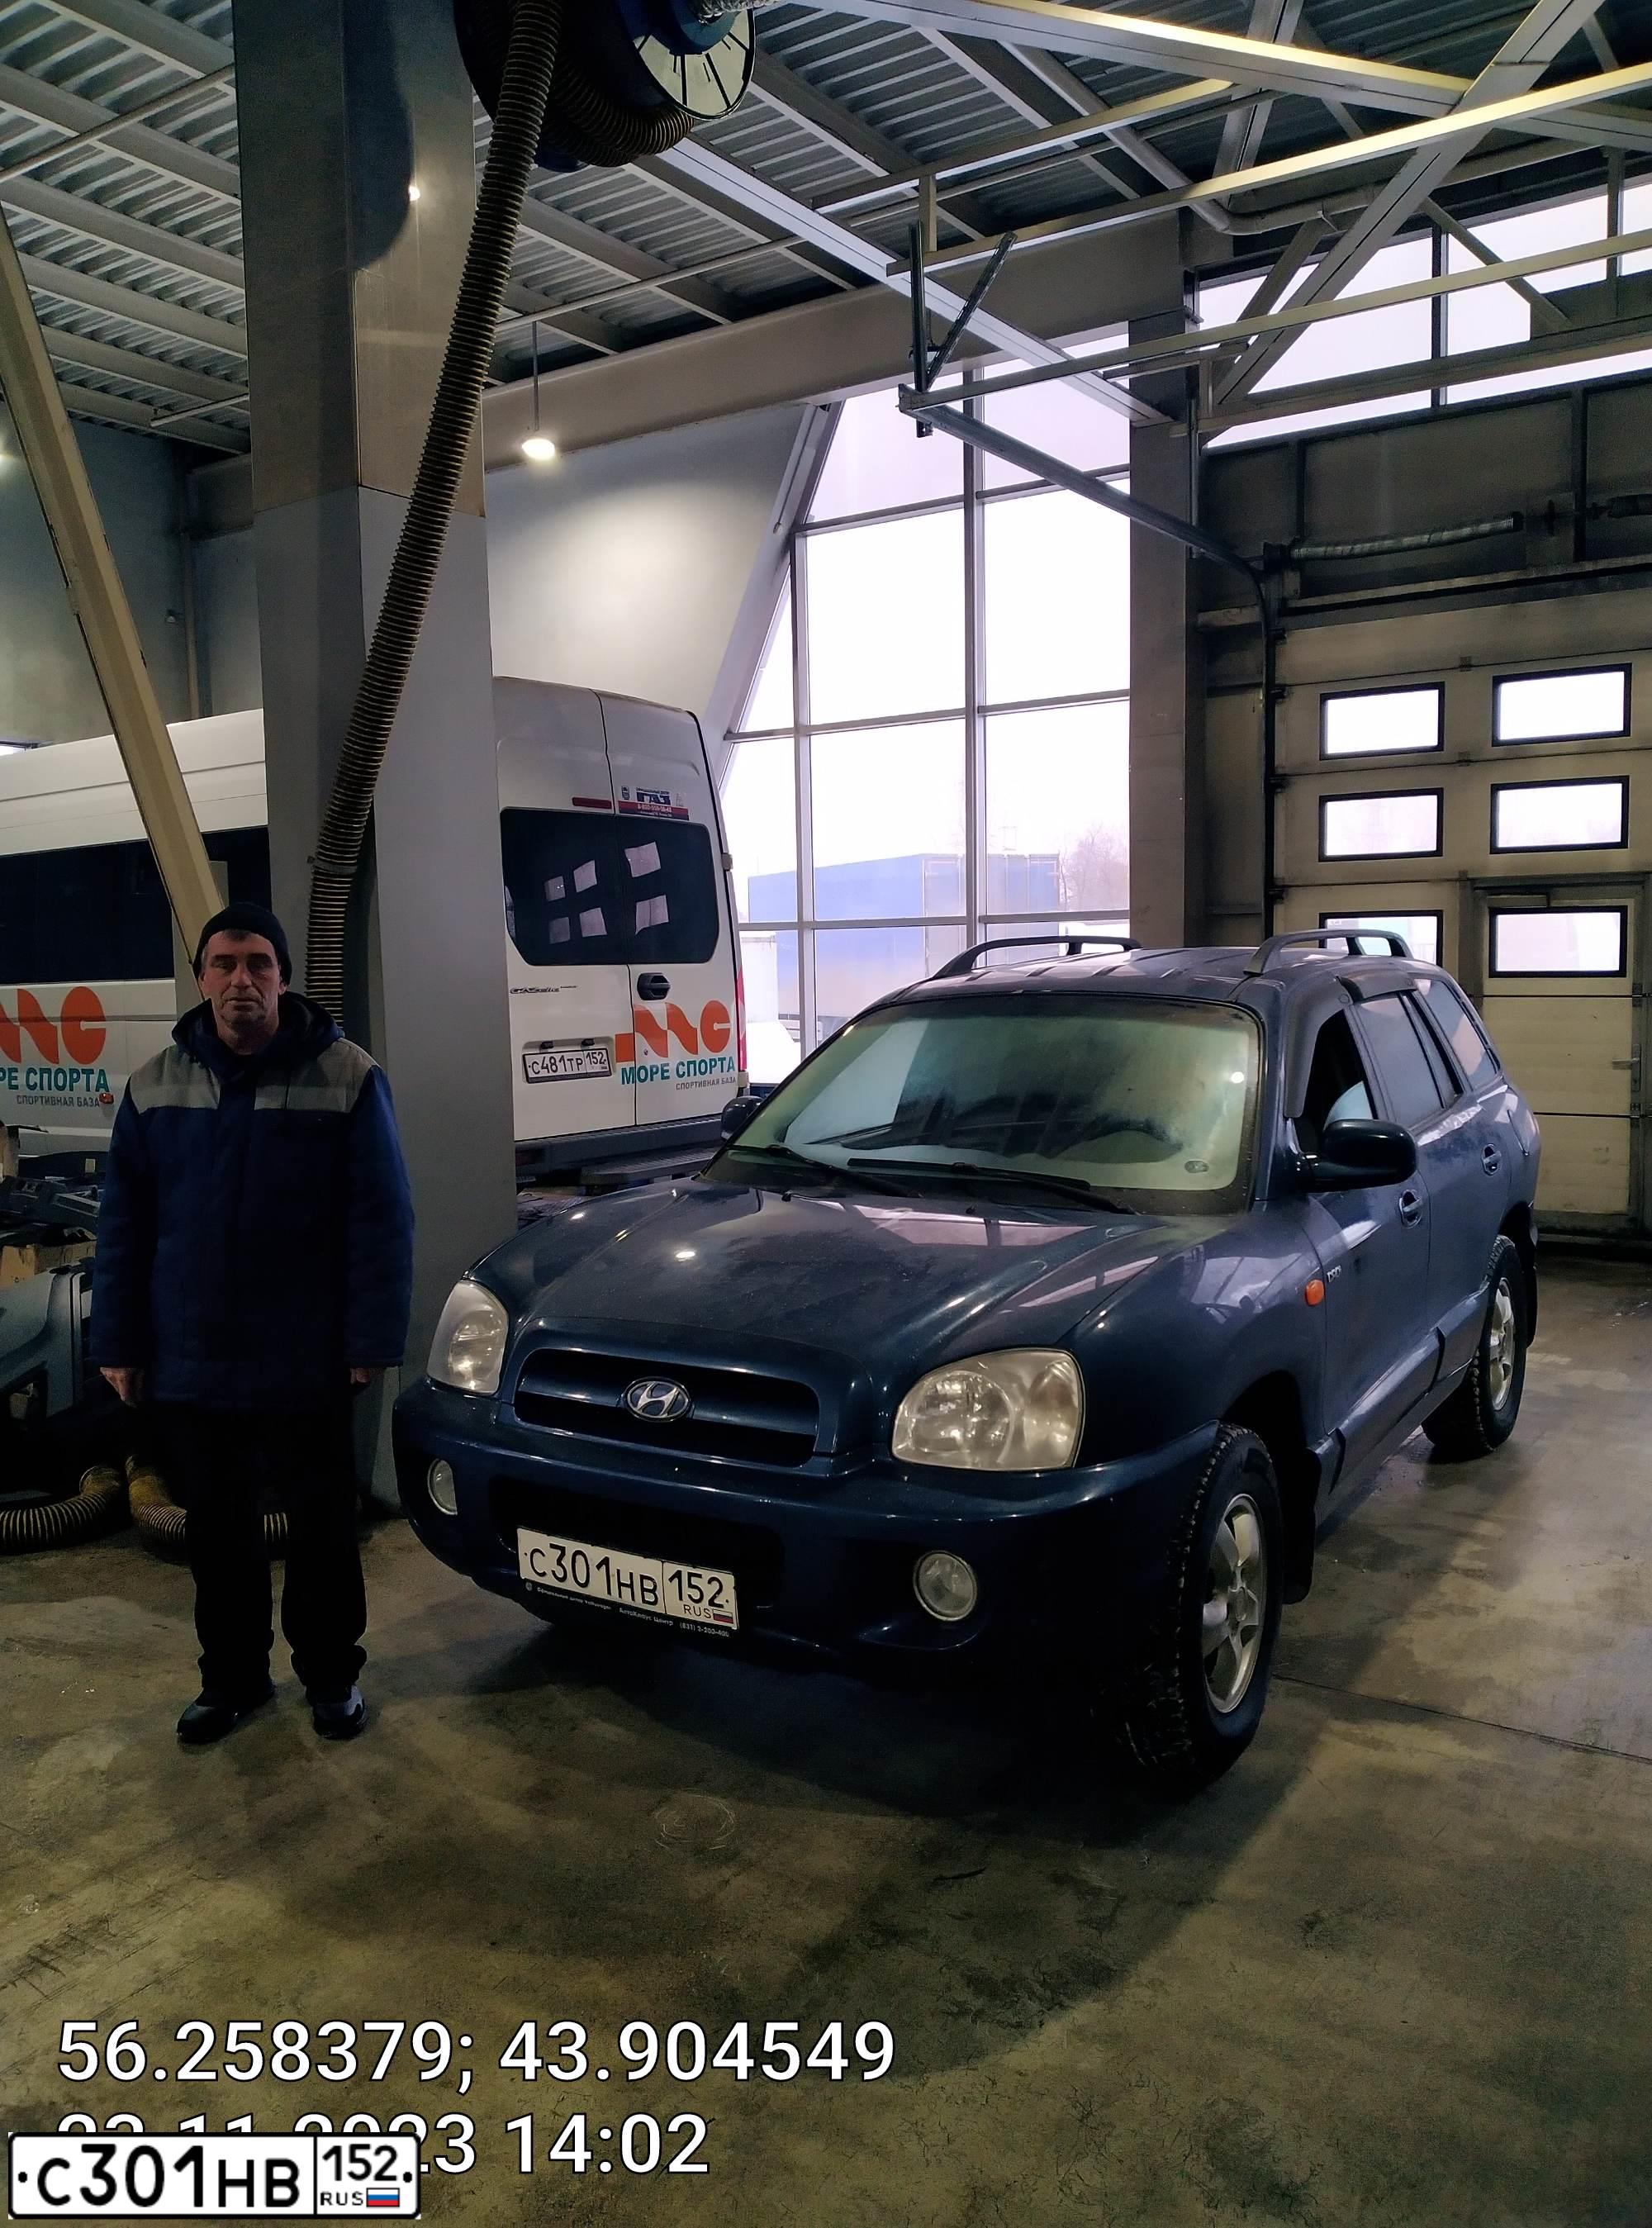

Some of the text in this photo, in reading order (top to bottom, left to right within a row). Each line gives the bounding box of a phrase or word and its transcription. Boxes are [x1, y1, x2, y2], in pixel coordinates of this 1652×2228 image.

[586, 1051, 605, 1065] 152
[621, 1056, 736, 1085] МОРЕ СПОРТА
[26, 1067, 110, 1092] СПОРТА
[676, 1080, 720, 1090] СПОРТИВНАЯ
[17, 1095, 100, 1108] СПОРТИВНАЯ БАЗА
[529, 1543, 724, 1608] С301НВ 152
[683, 1603, 712, 1619] RUS
